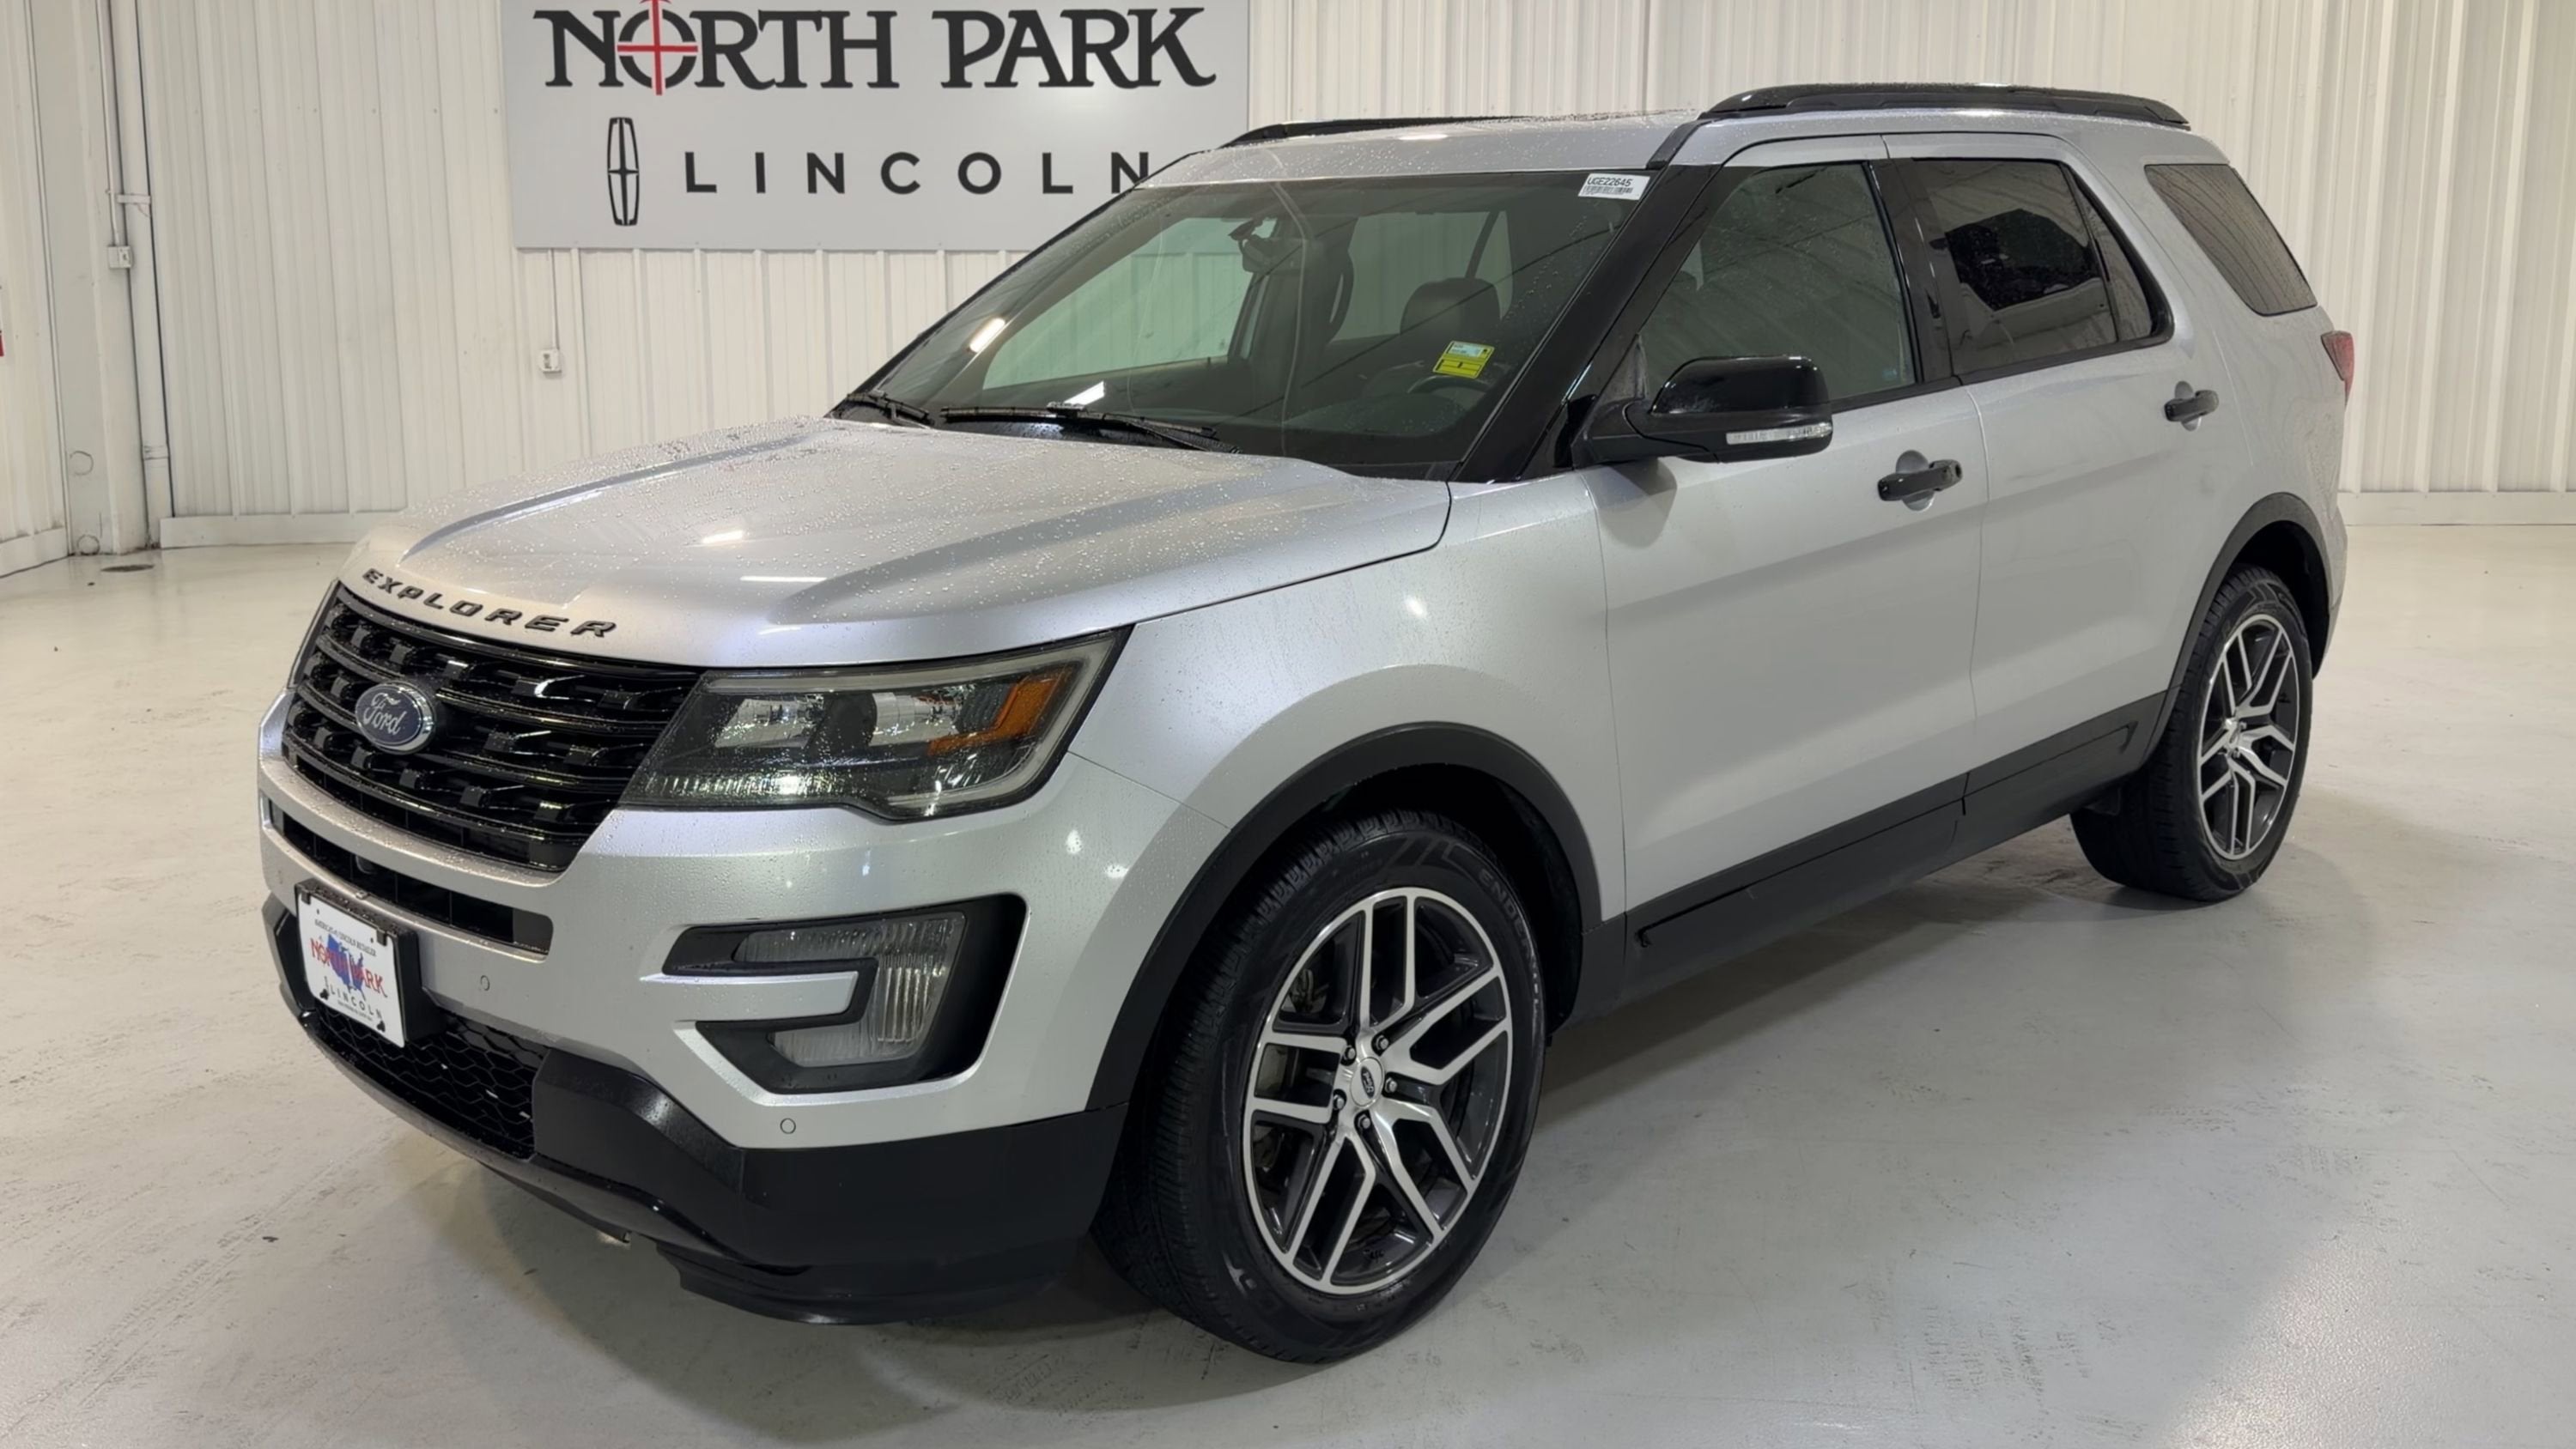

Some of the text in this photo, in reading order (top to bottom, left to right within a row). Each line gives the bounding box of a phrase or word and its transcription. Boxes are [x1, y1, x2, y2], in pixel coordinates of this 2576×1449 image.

[534, 6, 1218, 91] NORTH PARK
[685, 151, 1150, 195] LINCOLN
[361, 567, 617, 638] EXPLORER
[363, 691, 407, 736] Ford
[310, 937, 388, 997] NORTH PARK
[330, 984, 383, 1020] LINCOLN
